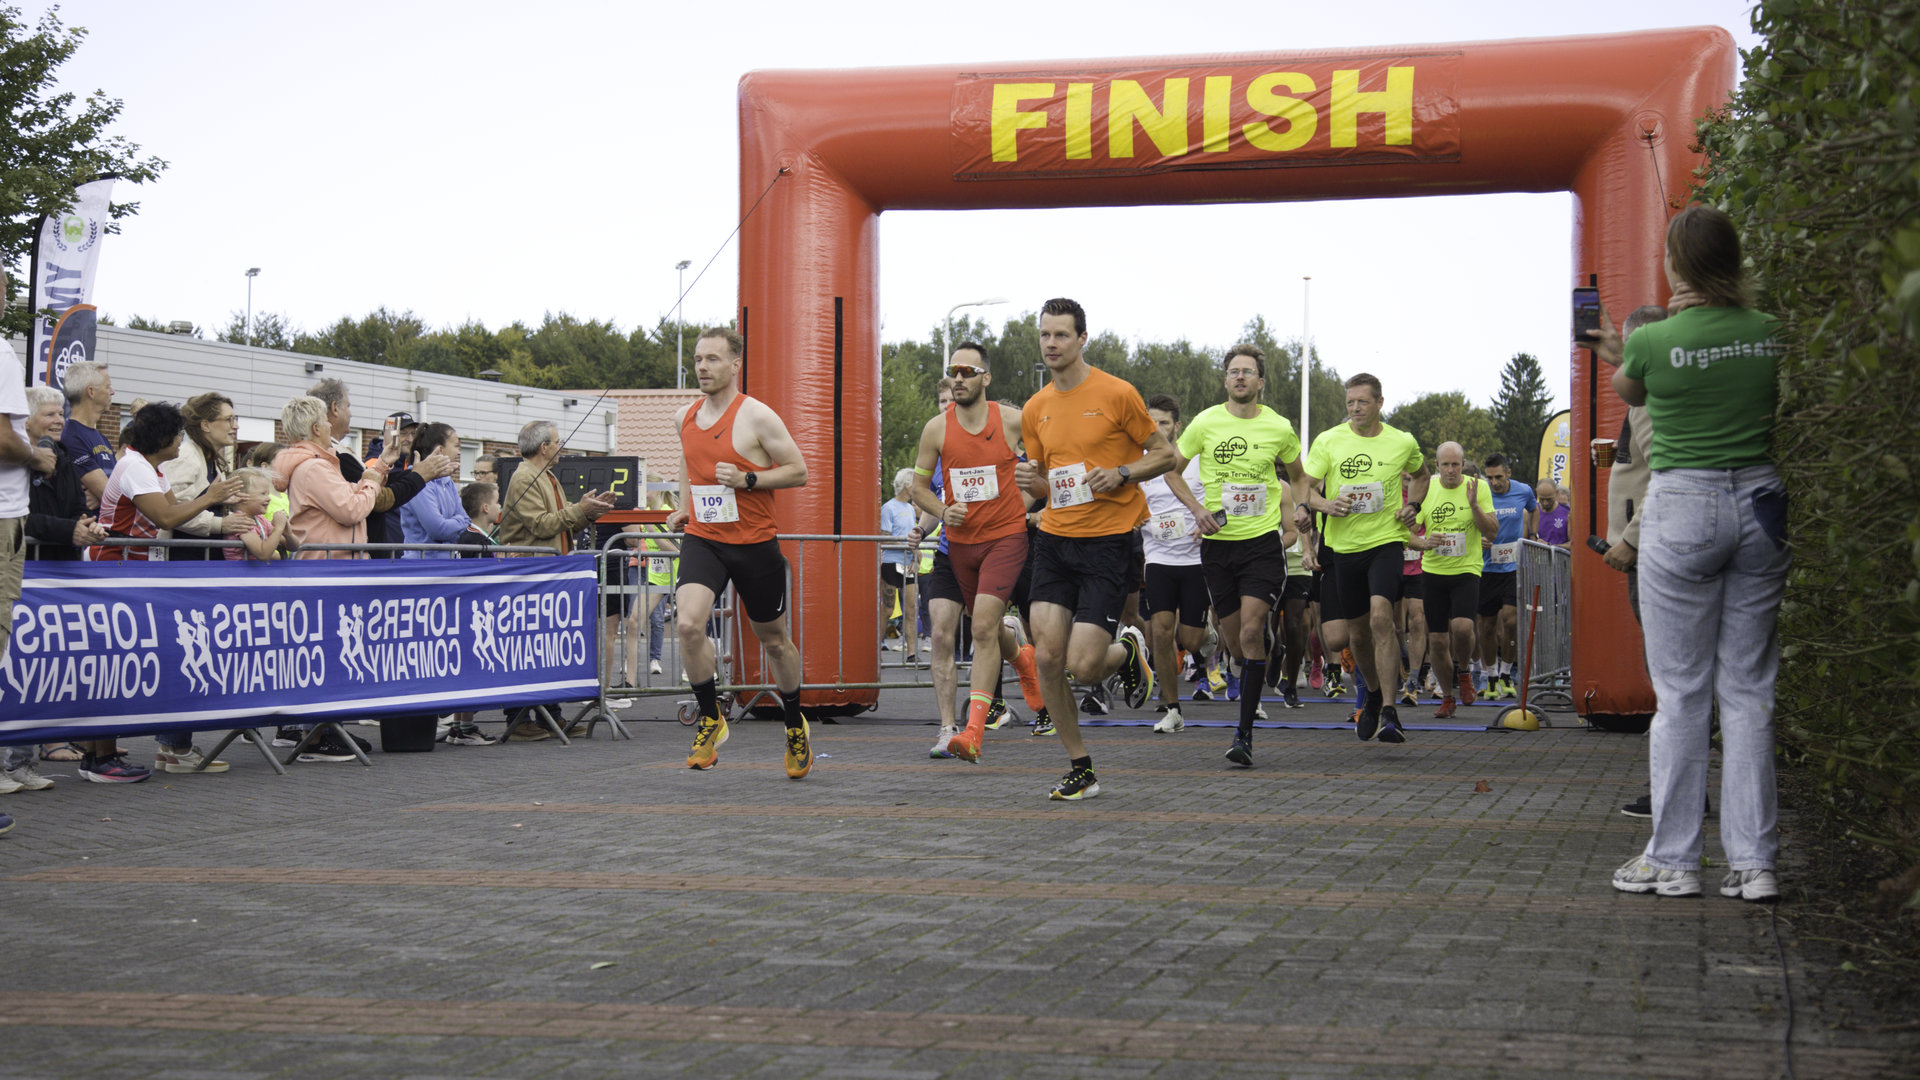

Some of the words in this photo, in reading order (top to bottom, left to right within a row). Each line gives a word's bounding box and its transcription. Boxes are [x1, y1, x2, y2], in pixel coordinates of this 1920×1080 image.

[991, 66, 1415, 163] FINISH
[961, 476, 985, 487] 490
[1055, 477, 1075, 490] 448
[701, 496, 723, 507] 109
[1233, 494, 1256, 503] 434
[1349, 492, 1372, 501] 479
[1159, 520, 1176, 529] 450
